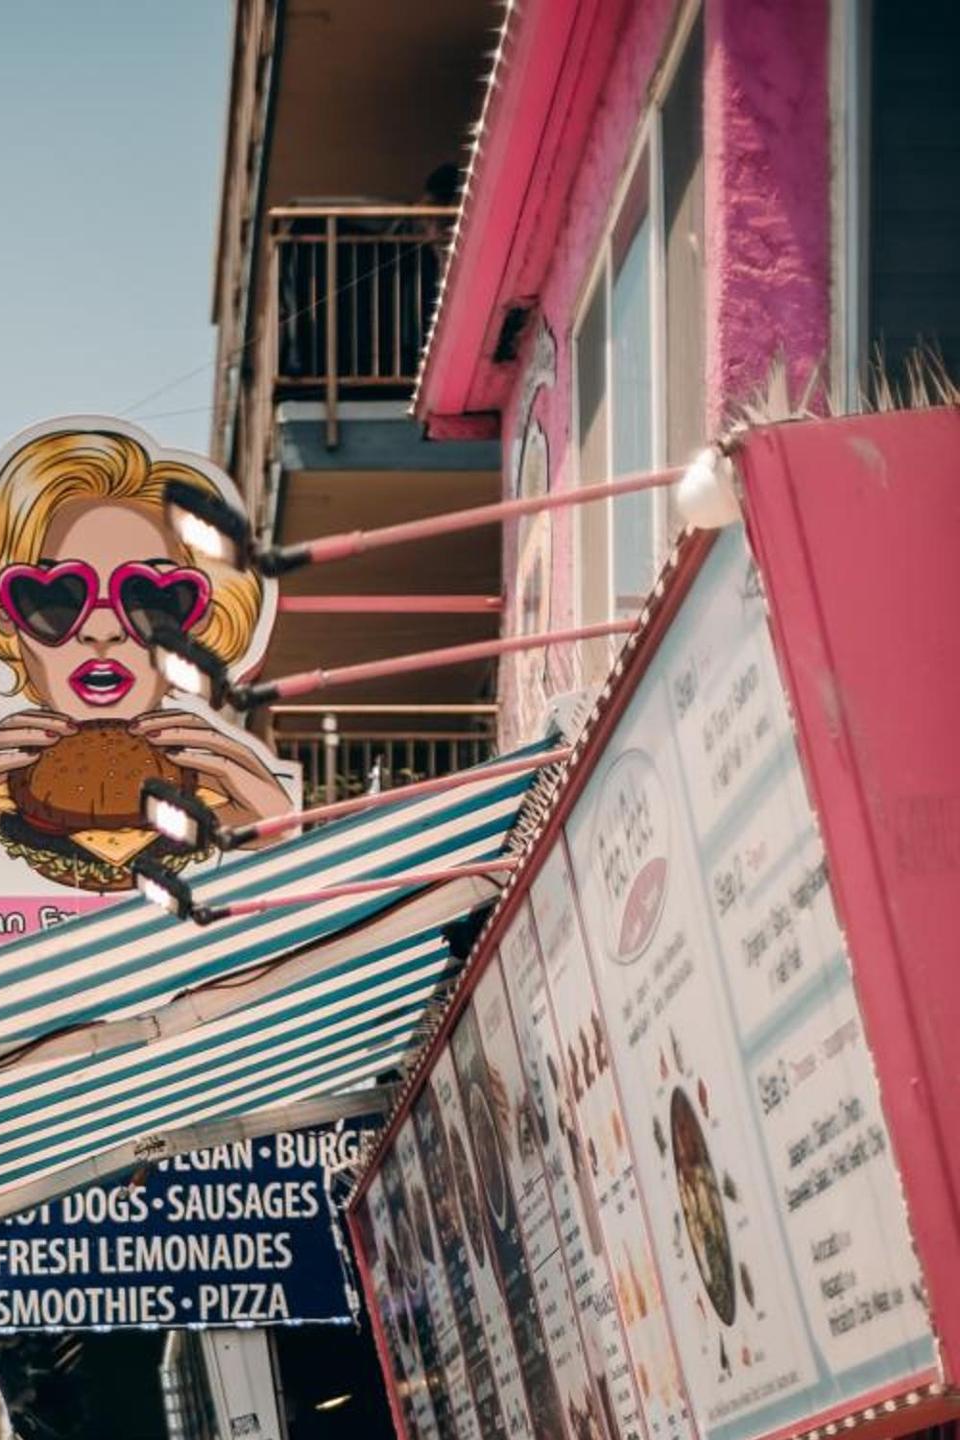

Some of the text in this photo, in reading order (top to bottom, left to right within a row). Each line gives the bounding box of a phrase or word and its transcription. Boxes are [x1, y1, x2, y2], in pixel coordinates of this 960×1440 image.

[63, 1186, 148, 1225] DOGS
[167, 1181, 319, 1222] SAUSAGES
[99, 1232, 292, 1273] LEMONADES
[199, 1283, 289, 1319] PIZZA
